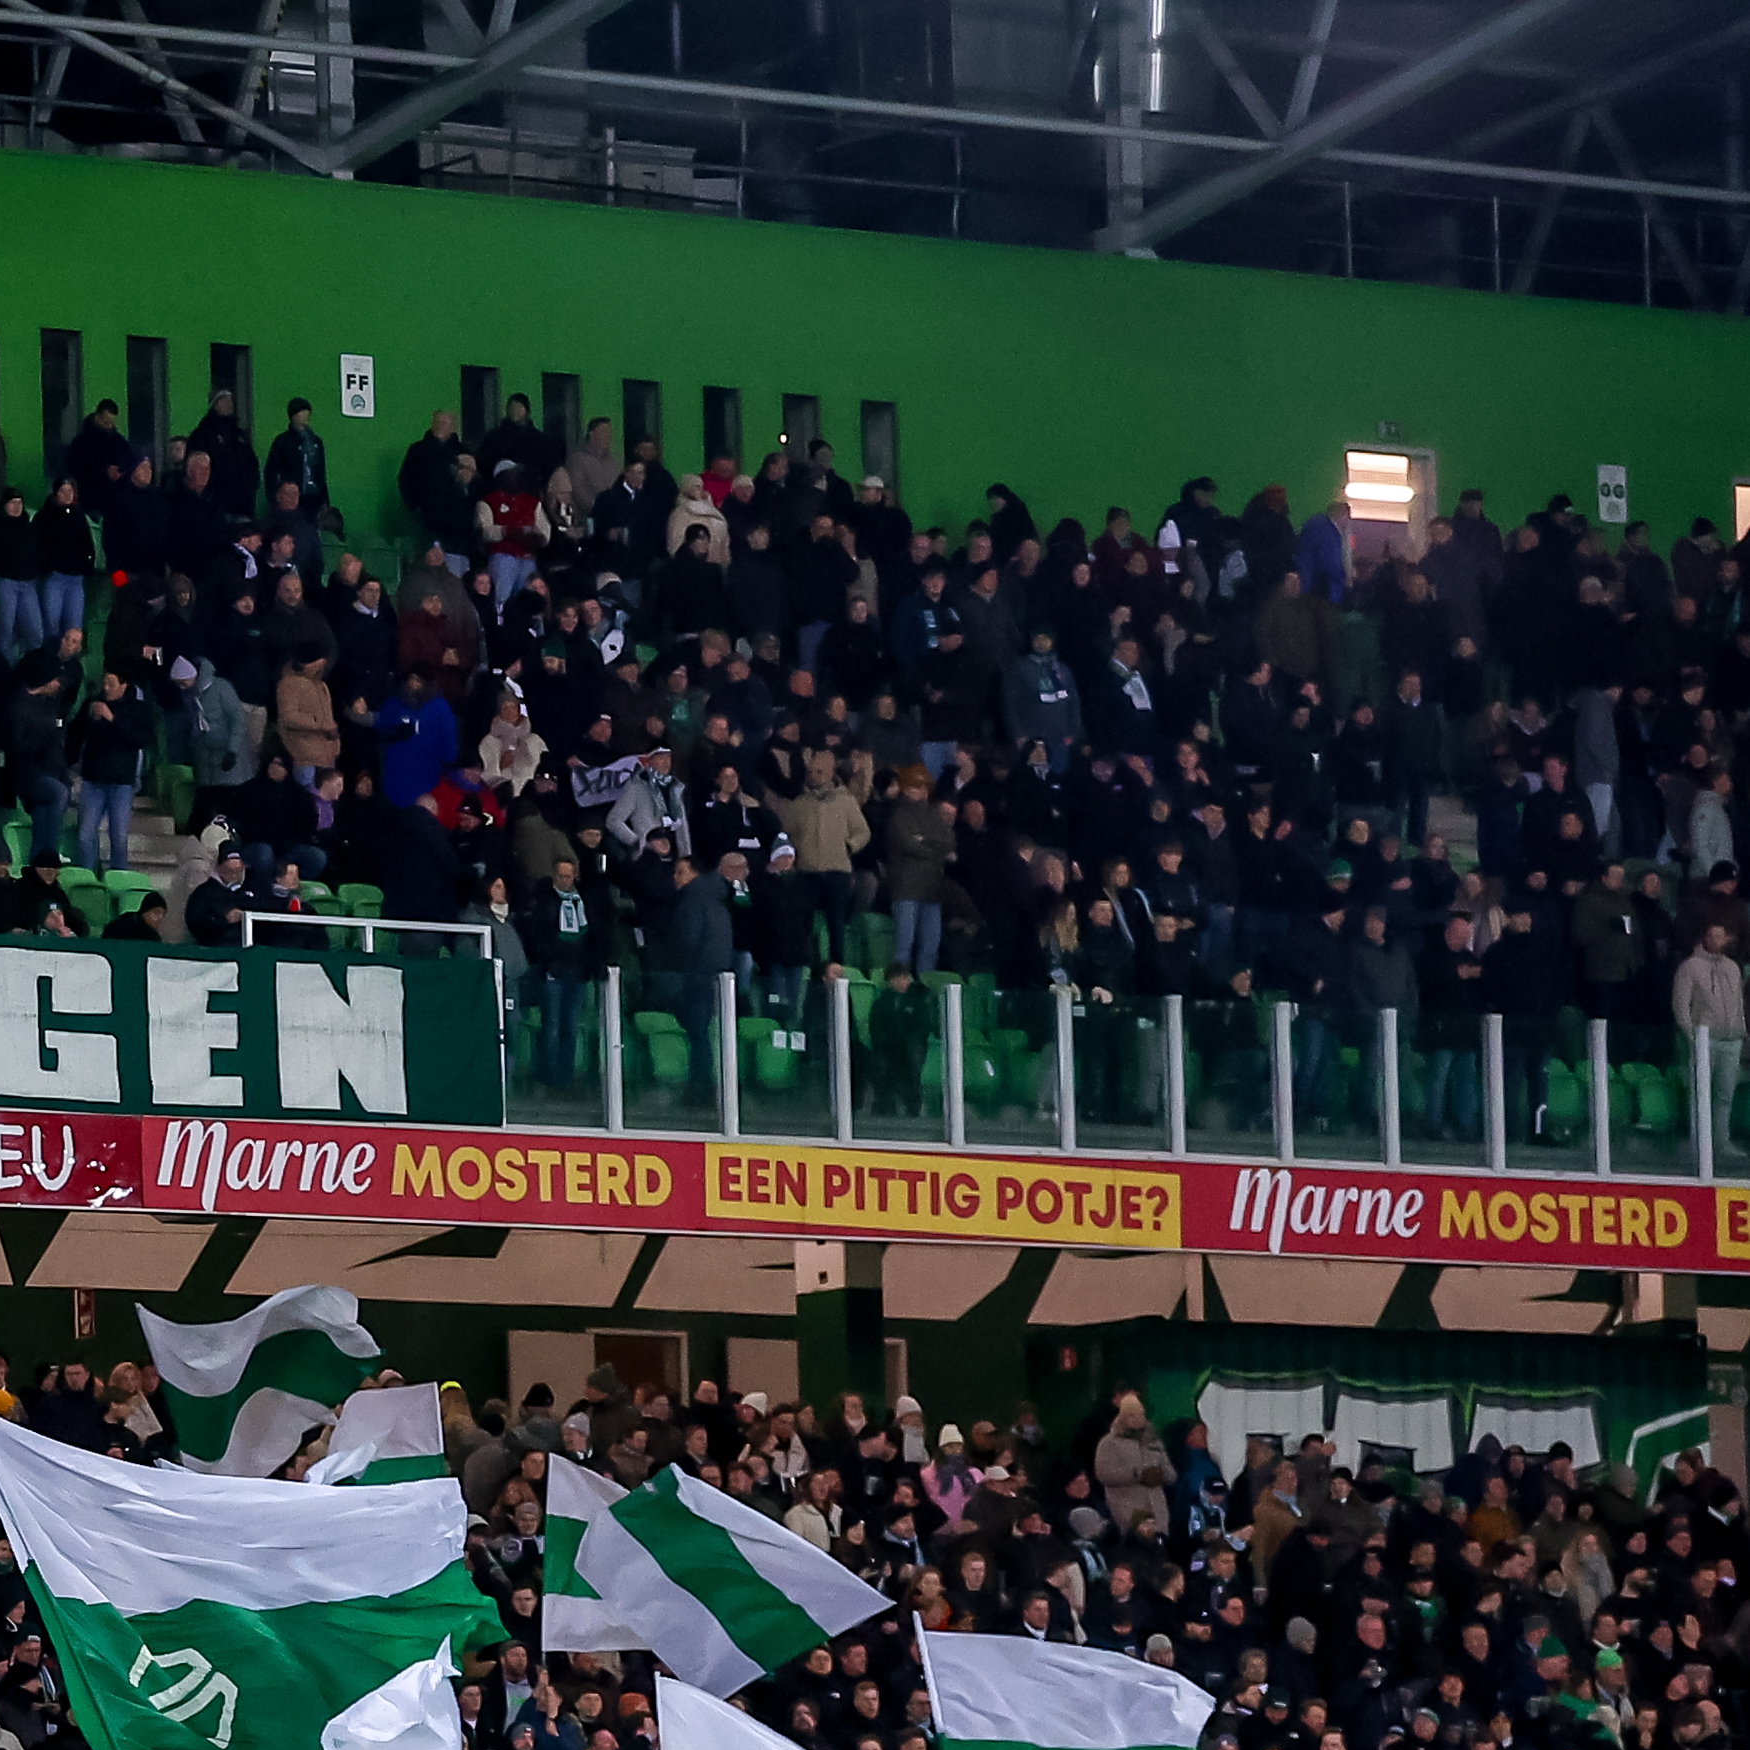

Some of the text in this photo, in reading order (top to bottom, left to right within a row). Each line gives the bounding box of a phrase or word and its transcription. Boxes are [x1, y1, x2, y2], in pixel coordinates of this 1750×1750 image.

[347, 374, 368, 391] FF
[156, 1118, 672, 1213] Marne MOSTERD
[718, 1156, 1171, 1231] EEN PITTIG POTJE?
[1230, 1167, 1689, 1255] Marne MOSTERD
